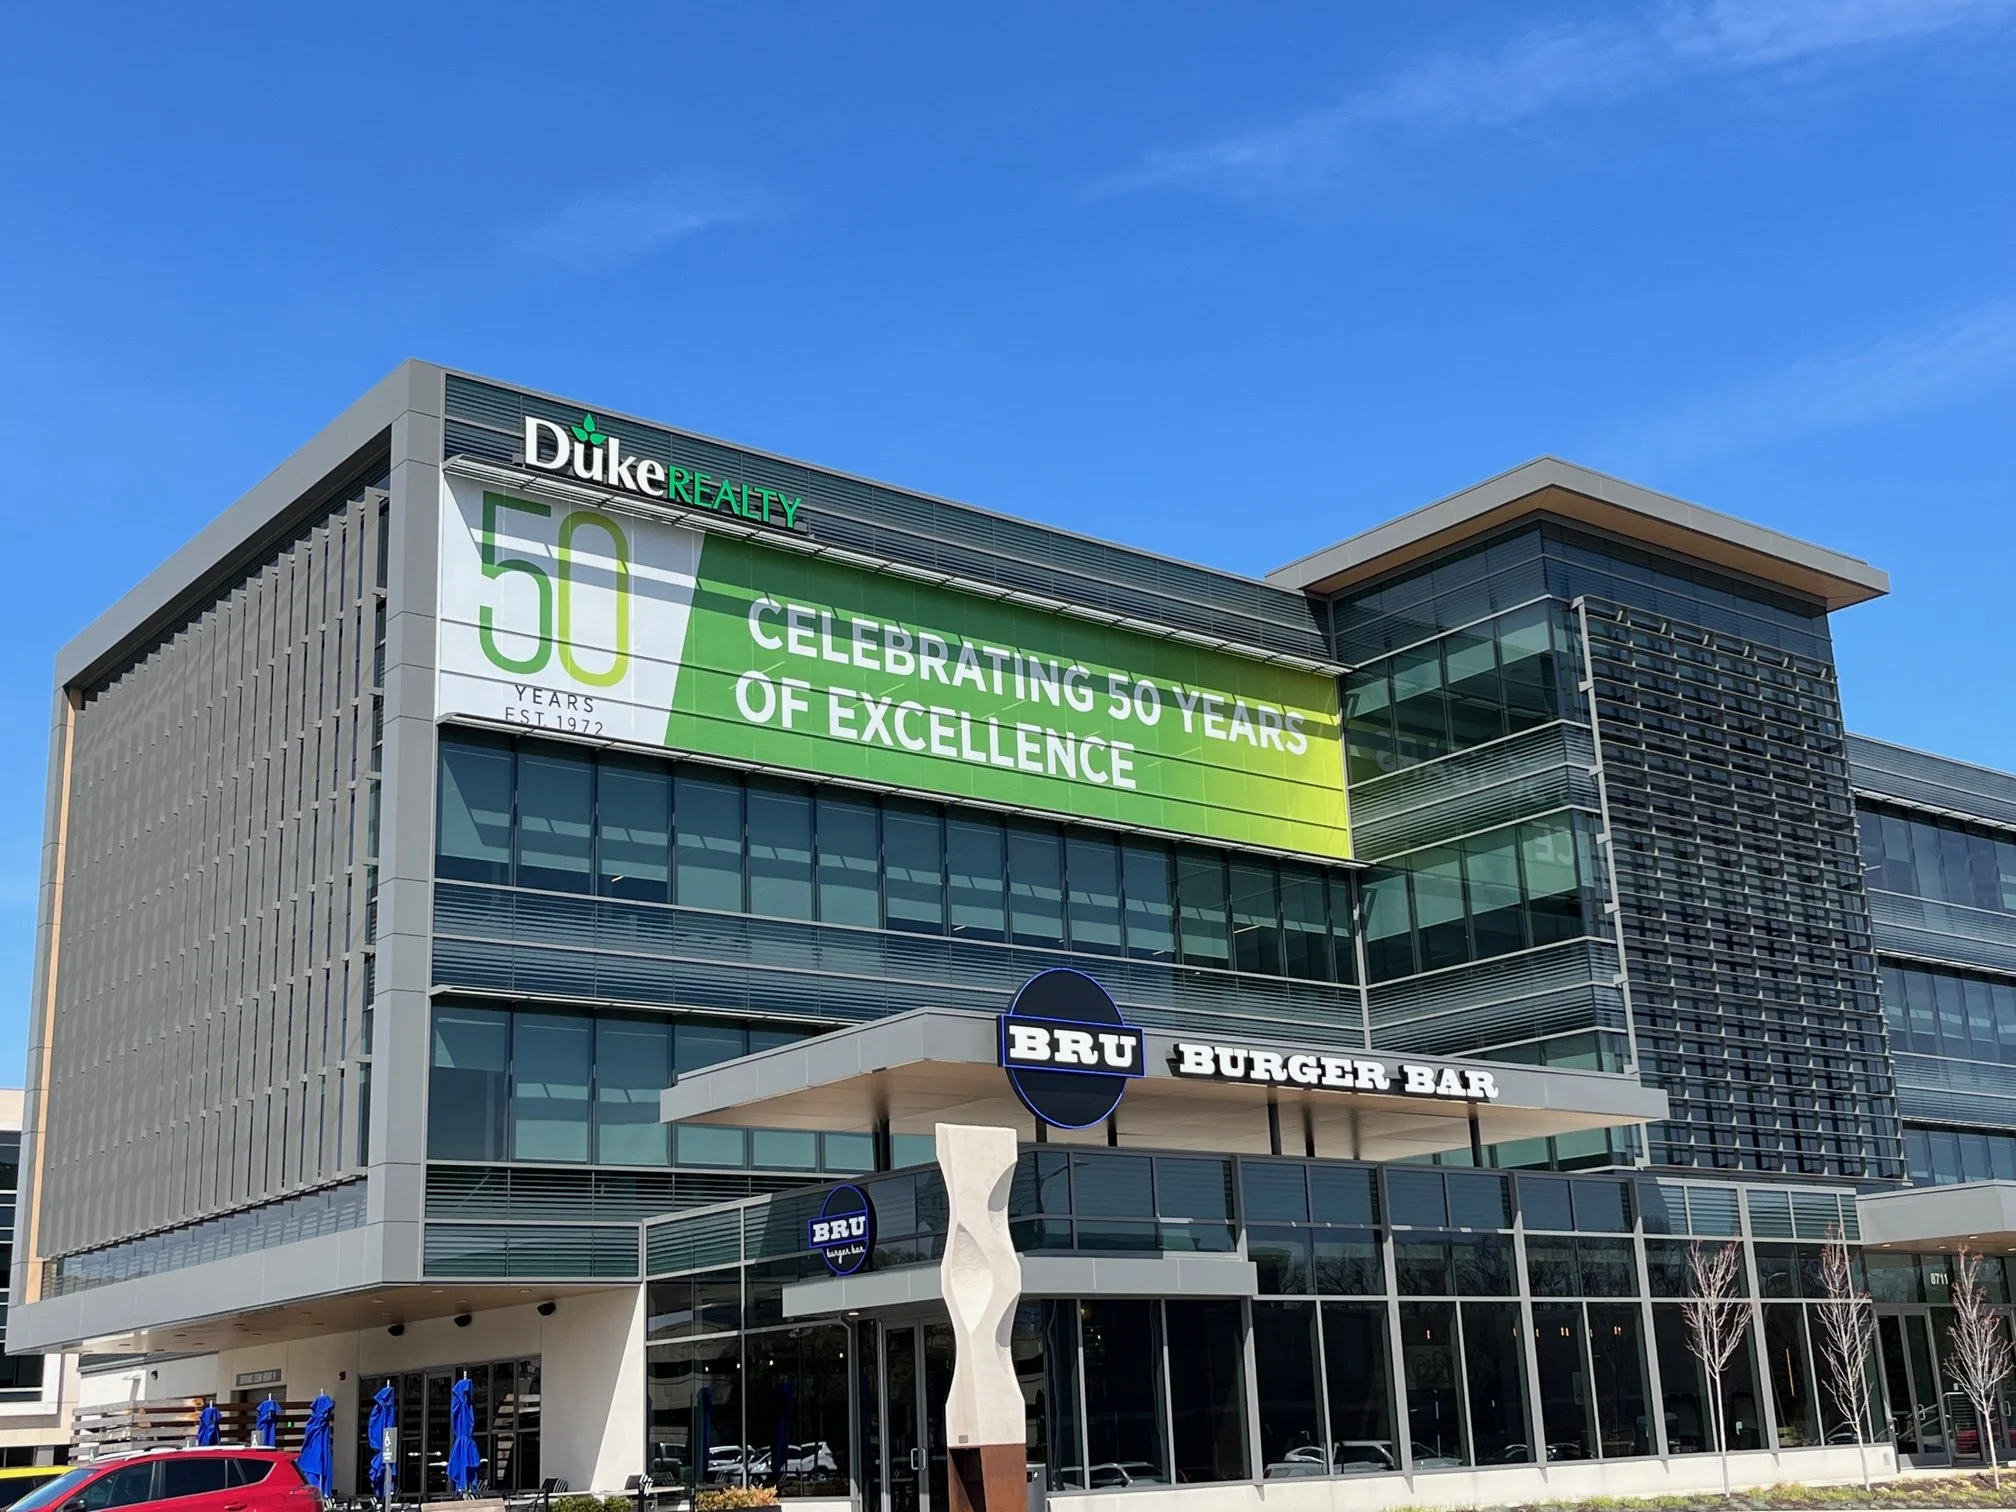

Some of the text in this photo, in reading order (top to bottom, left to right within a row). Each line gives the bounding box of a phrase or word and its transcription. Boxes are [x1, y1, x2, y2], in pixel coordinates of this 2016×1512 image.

[667, 464, 803, 529] REALTY
[479, 491, 629, 687] 50
[515, 684, 594, 713] YEARS
[747, 597, 1094, 712] CELEBRATING
[1106, 673, 1162, 727] 50
[1170, 689, 1309, 756] YEARS
[505, 706, 604, 736] EST. 1972
[734, 670, 1138, 790] OF EXCELLENCE
[1008, 1024, 1137, 1068] BRU
[1176, 1042, 1499, 1099] BURGER BAR
[812, 1215, 866, 1243] BRU
[1930, 1272, 1948, 1285] 8711
